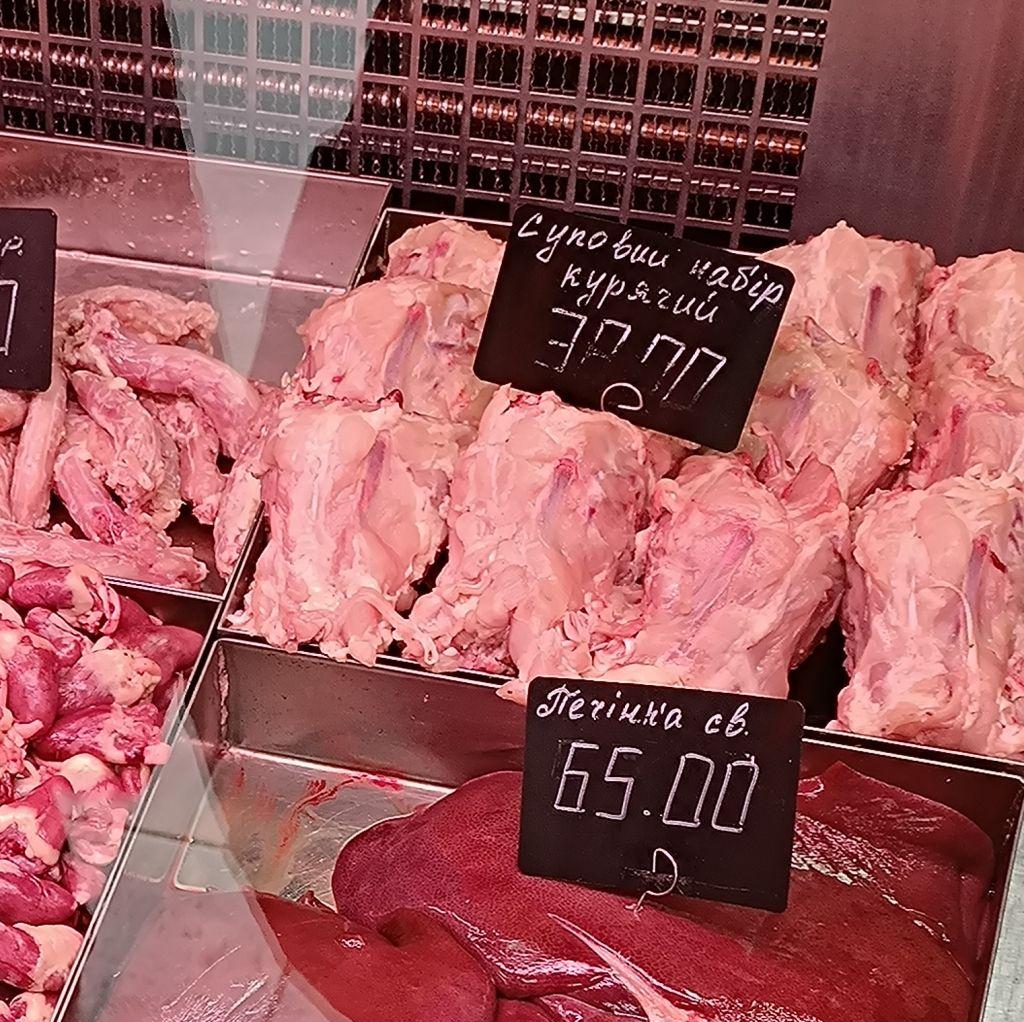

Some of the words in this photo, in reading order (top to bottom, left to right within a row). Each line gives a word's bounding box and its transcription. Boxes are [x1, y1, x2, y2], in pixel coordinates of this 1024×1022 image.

[560, 262, 719, 324] курячий
[688, 258, 785, 312] набір
[553, 741, 760, 834] 65.00
